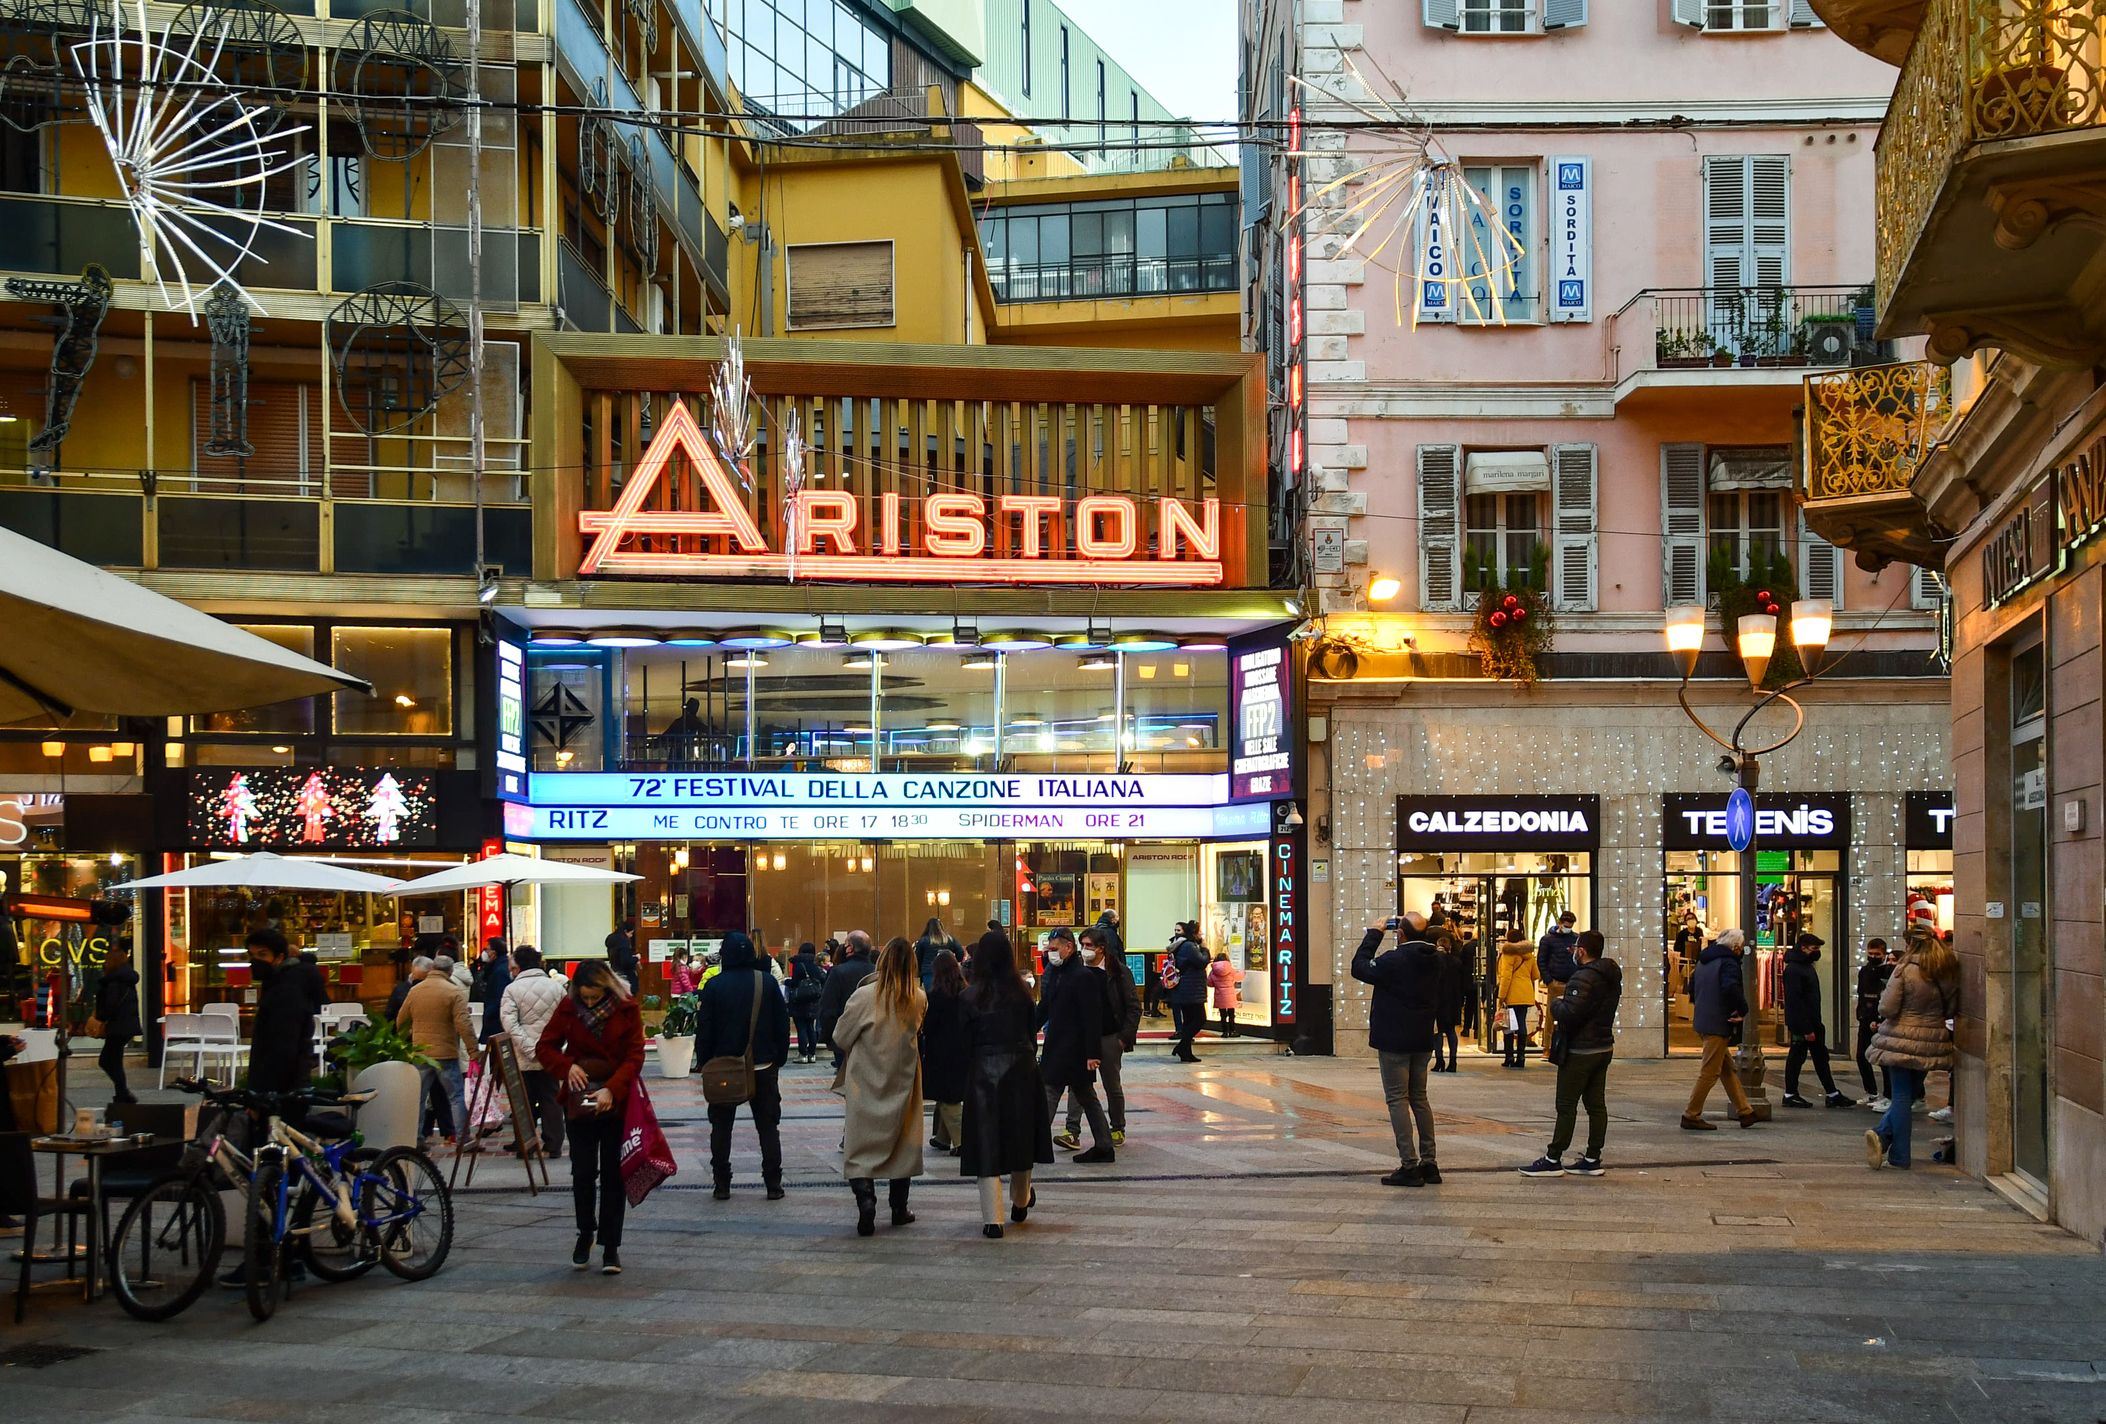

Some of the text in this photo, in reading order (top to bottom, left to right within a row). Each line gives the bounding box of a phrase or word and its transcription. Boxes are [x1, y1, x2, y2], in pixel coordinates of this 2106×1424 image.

[579, 400, 1223, 581] ARISTON
[1246, 703, 1277, 739] FFP2
[674, 778, 794, 798] FESTIVAL
[808, 779, 889, 799] DELLA
[903, 780, 1021, 799] CANZONE
[1038, 779, 1145, 798] ITALIANA
[549, 810, 608, 829] RITZ
[654, 815, 679, 829] ME
[694, 815, 767, 830] CONTRO
[780, 816, 799, 829] TE
[813, 815, 849, 829] ORE
[861, 815, 877, 829] 17
[958, 813, 1064, 828] SPIDERMAN
[1085, 813, 1120, 827] ORE
[1128, 813, 1145, 828] 21
[1409, 811, 1589, 833] CALZEDONIA
[1278, 844, 1292, 1015] CINEMA RITZ
